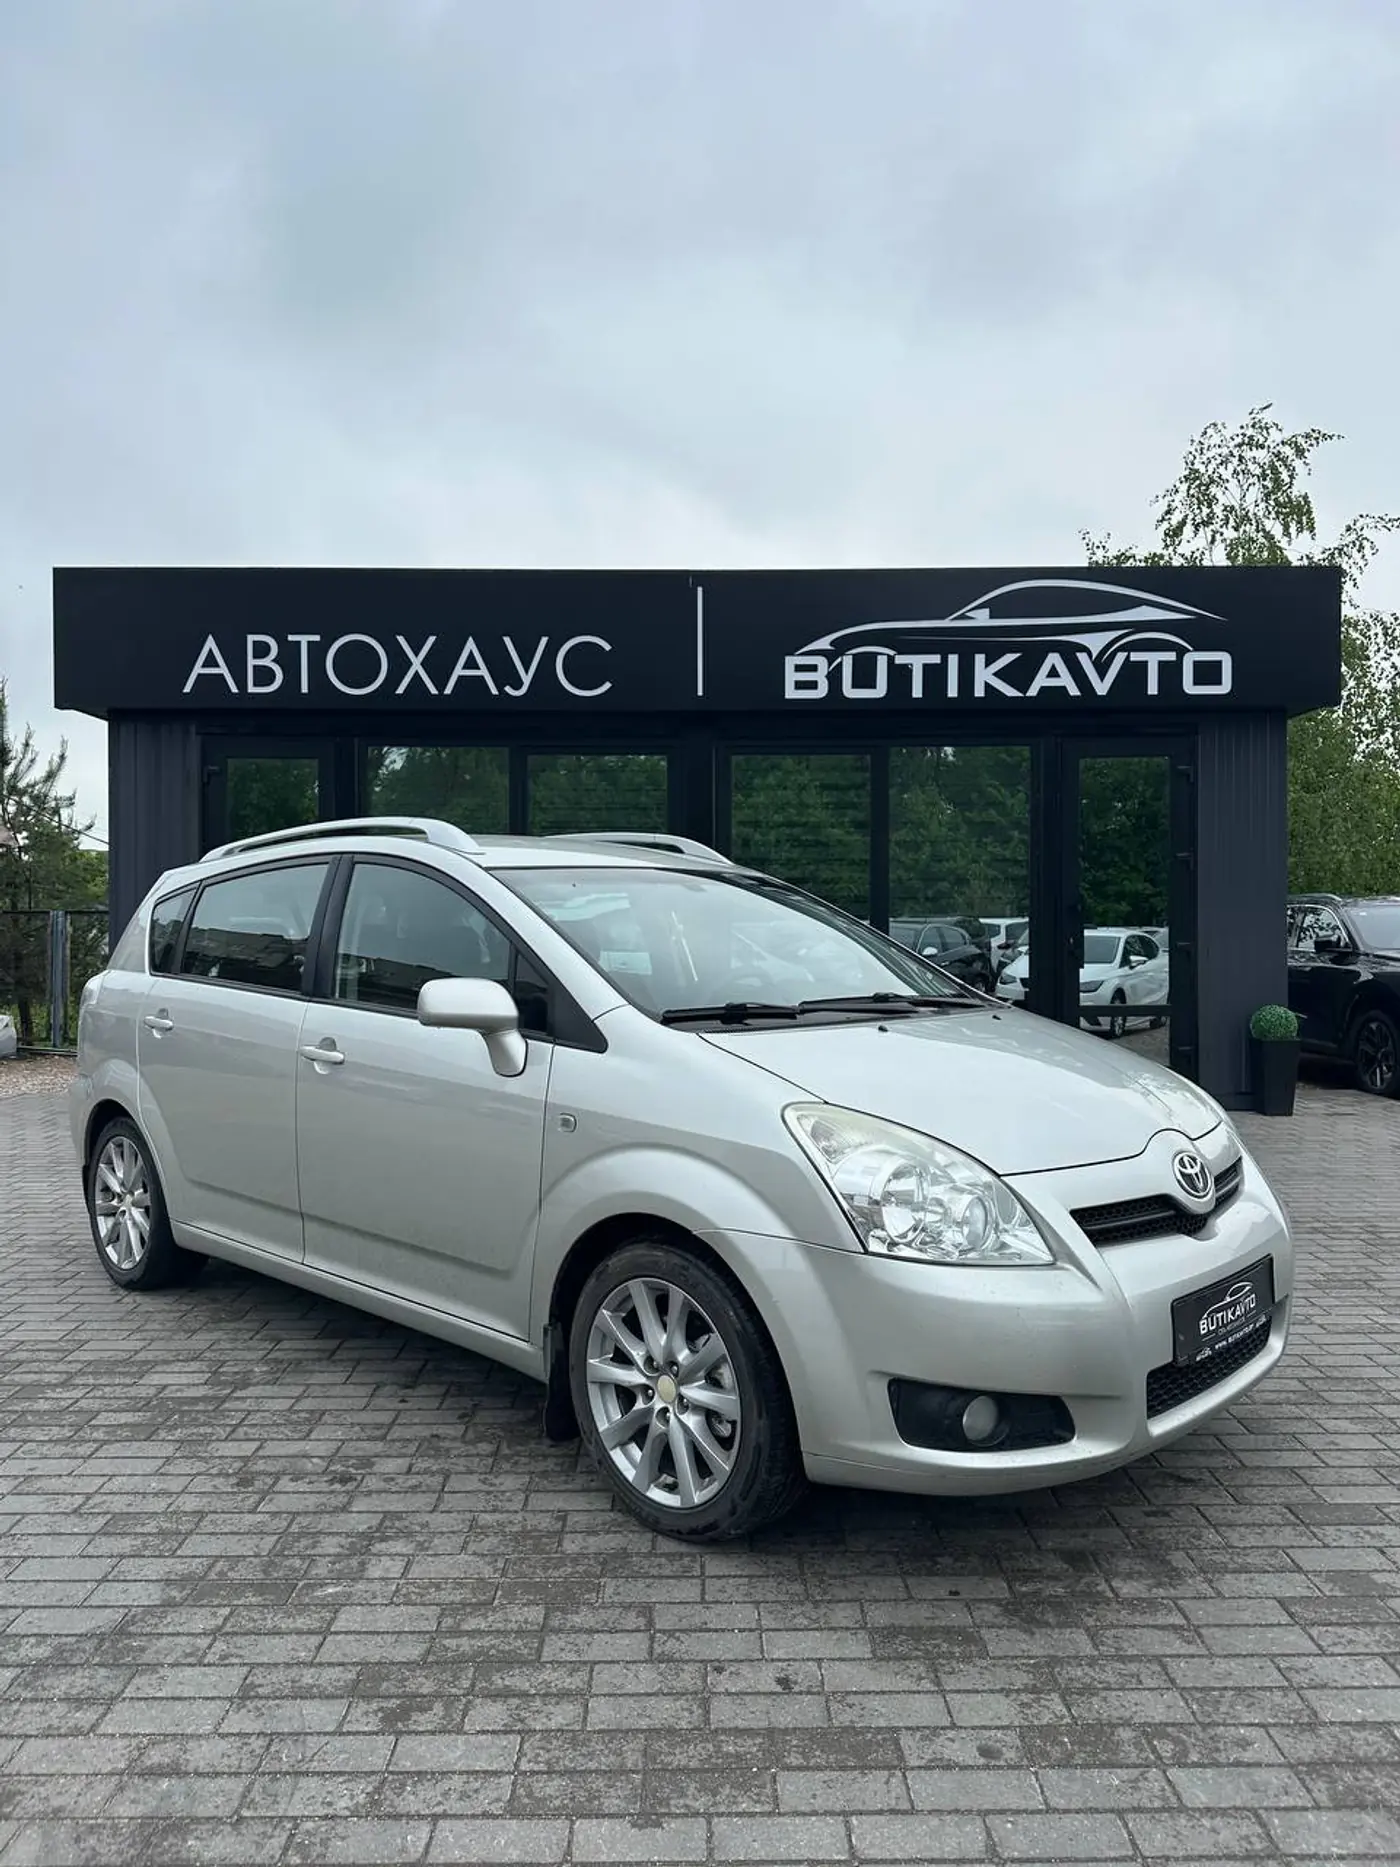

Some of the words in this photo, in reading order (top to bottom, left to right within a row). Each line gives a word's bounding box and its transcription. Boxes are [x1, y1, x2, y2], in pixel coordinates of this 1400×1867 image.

[183, 634, 613, 697] АВТОХАУС
[785, 650, 1233, 699] BUTIKAVTO
[1199, 1294, 1256, 1335] BUTIKAVTO
